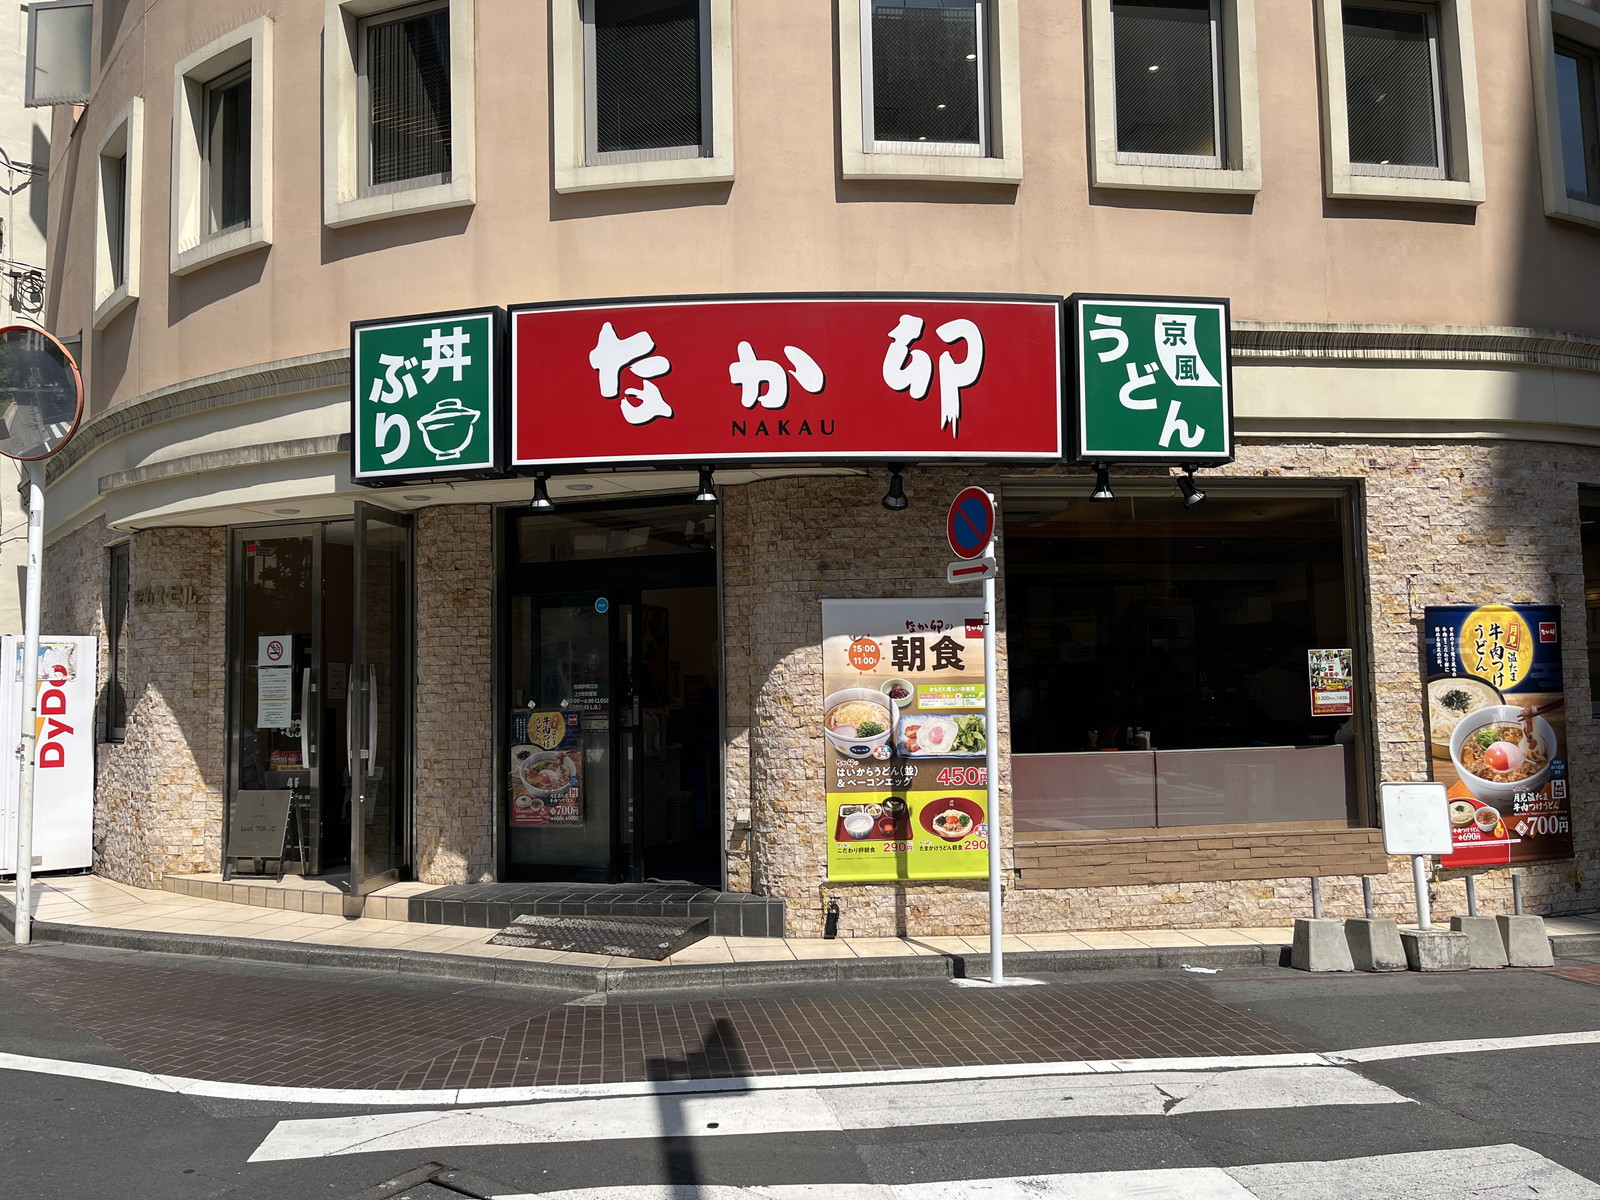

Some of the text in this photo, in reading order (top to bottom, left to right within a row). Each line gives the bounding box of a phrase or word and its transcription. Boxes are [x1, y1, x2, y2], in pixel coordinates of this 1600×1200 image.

[1162, 320, 1200, 381] 京風
[588, 313, 986, 438] なか卯
[1089, 313, 1206, 448] うどん
[732, 419, 836, 437] NAKAU
[905, 619, 954, 633] なか卯の
[891, 635, 966, 672] 朝食
[1474, 624, 1489, 672] うどん
[1488, 622, 1505, 688] 牛肉つけ
[1507, 652, 1518, 682] 温たま
[39, 664, 74, 768] DyDo
[286, 777, 300, 788] 4F
[1512, 801, 1560, 812] 牛肉つけうどん
[1527, 815, 1569, 836] 700円
[883, 842, 914, 853] 290円
[964, 840, 989, 850] 290
